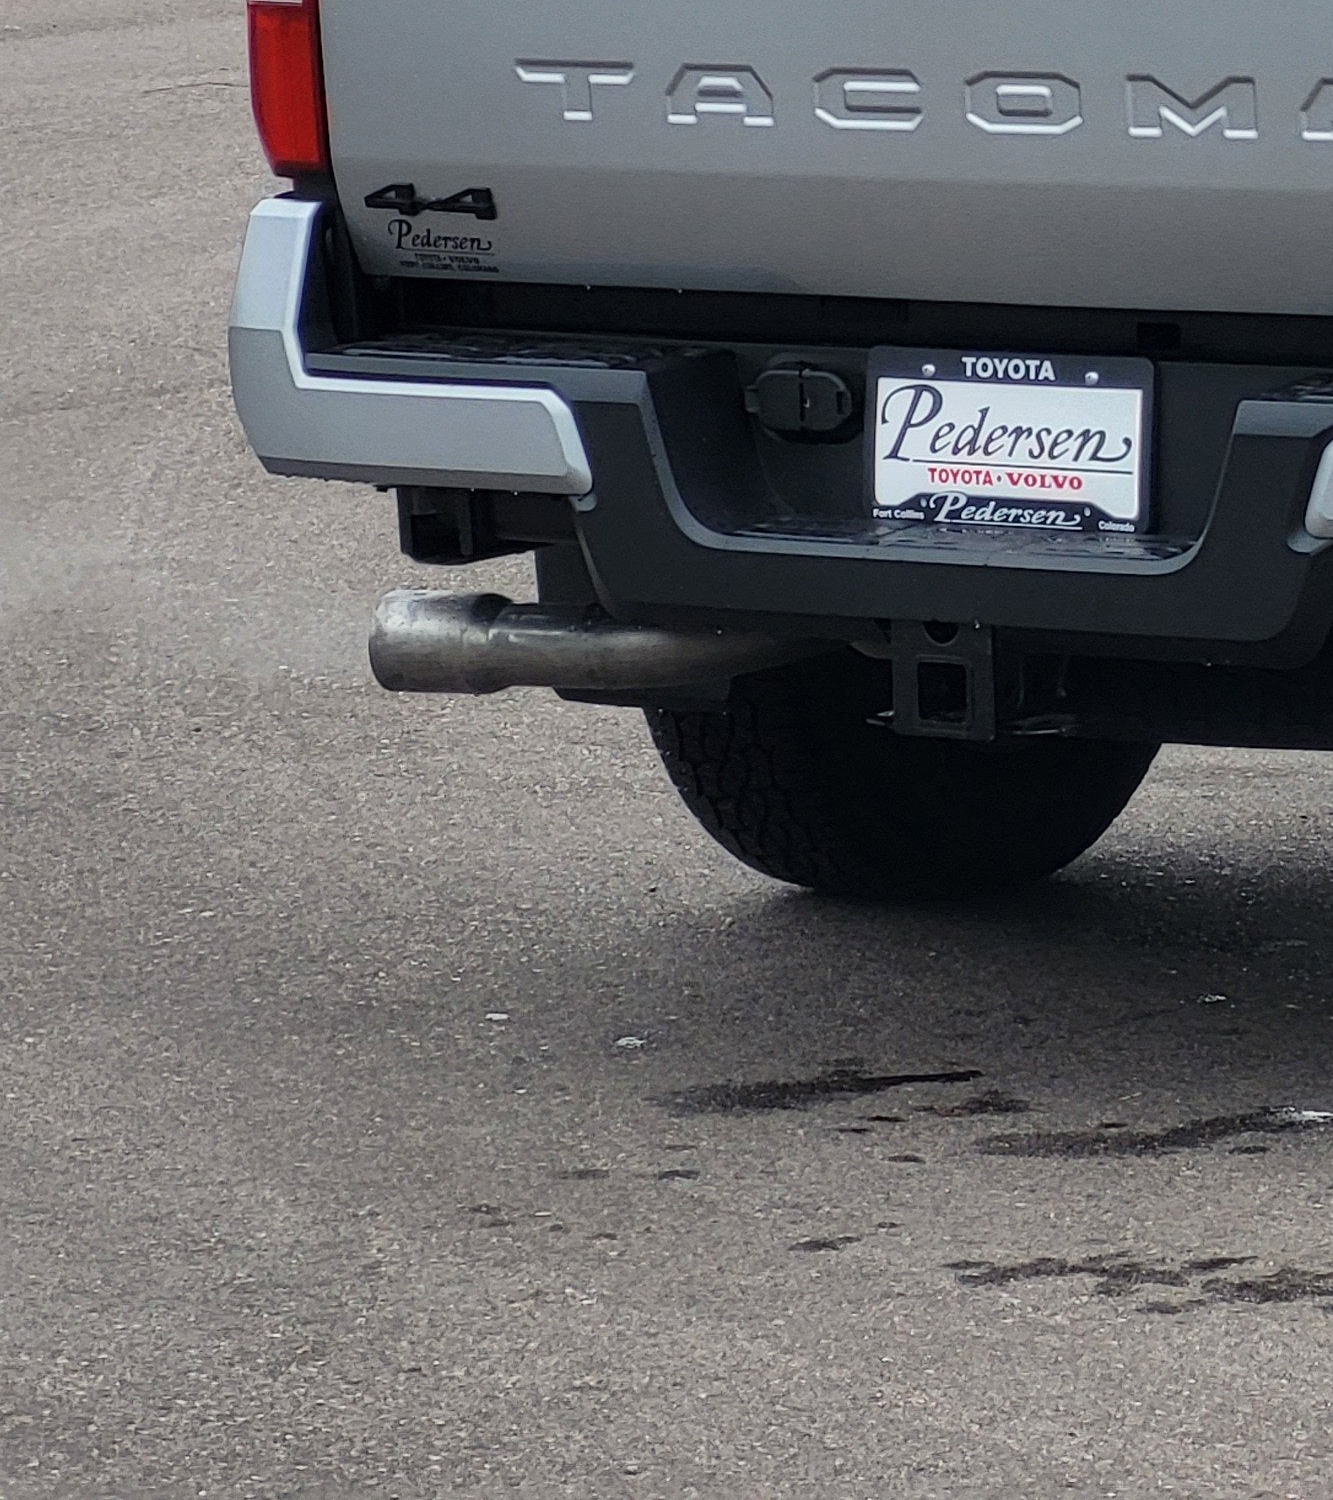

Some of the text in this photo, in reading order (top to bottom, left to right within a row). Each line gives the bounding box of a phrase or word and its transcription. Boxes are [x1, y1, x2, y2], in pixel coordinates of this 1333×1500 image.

[387, 218, 493, 251] Pedersen
[961, 356, 1056, 382] TOYOTA
[881, 383, 1132, 463] Pedersen
[927, 467, 1083, 490] TOYOTA VOLVO
[929, 491, 1081, 526] Pedersen
